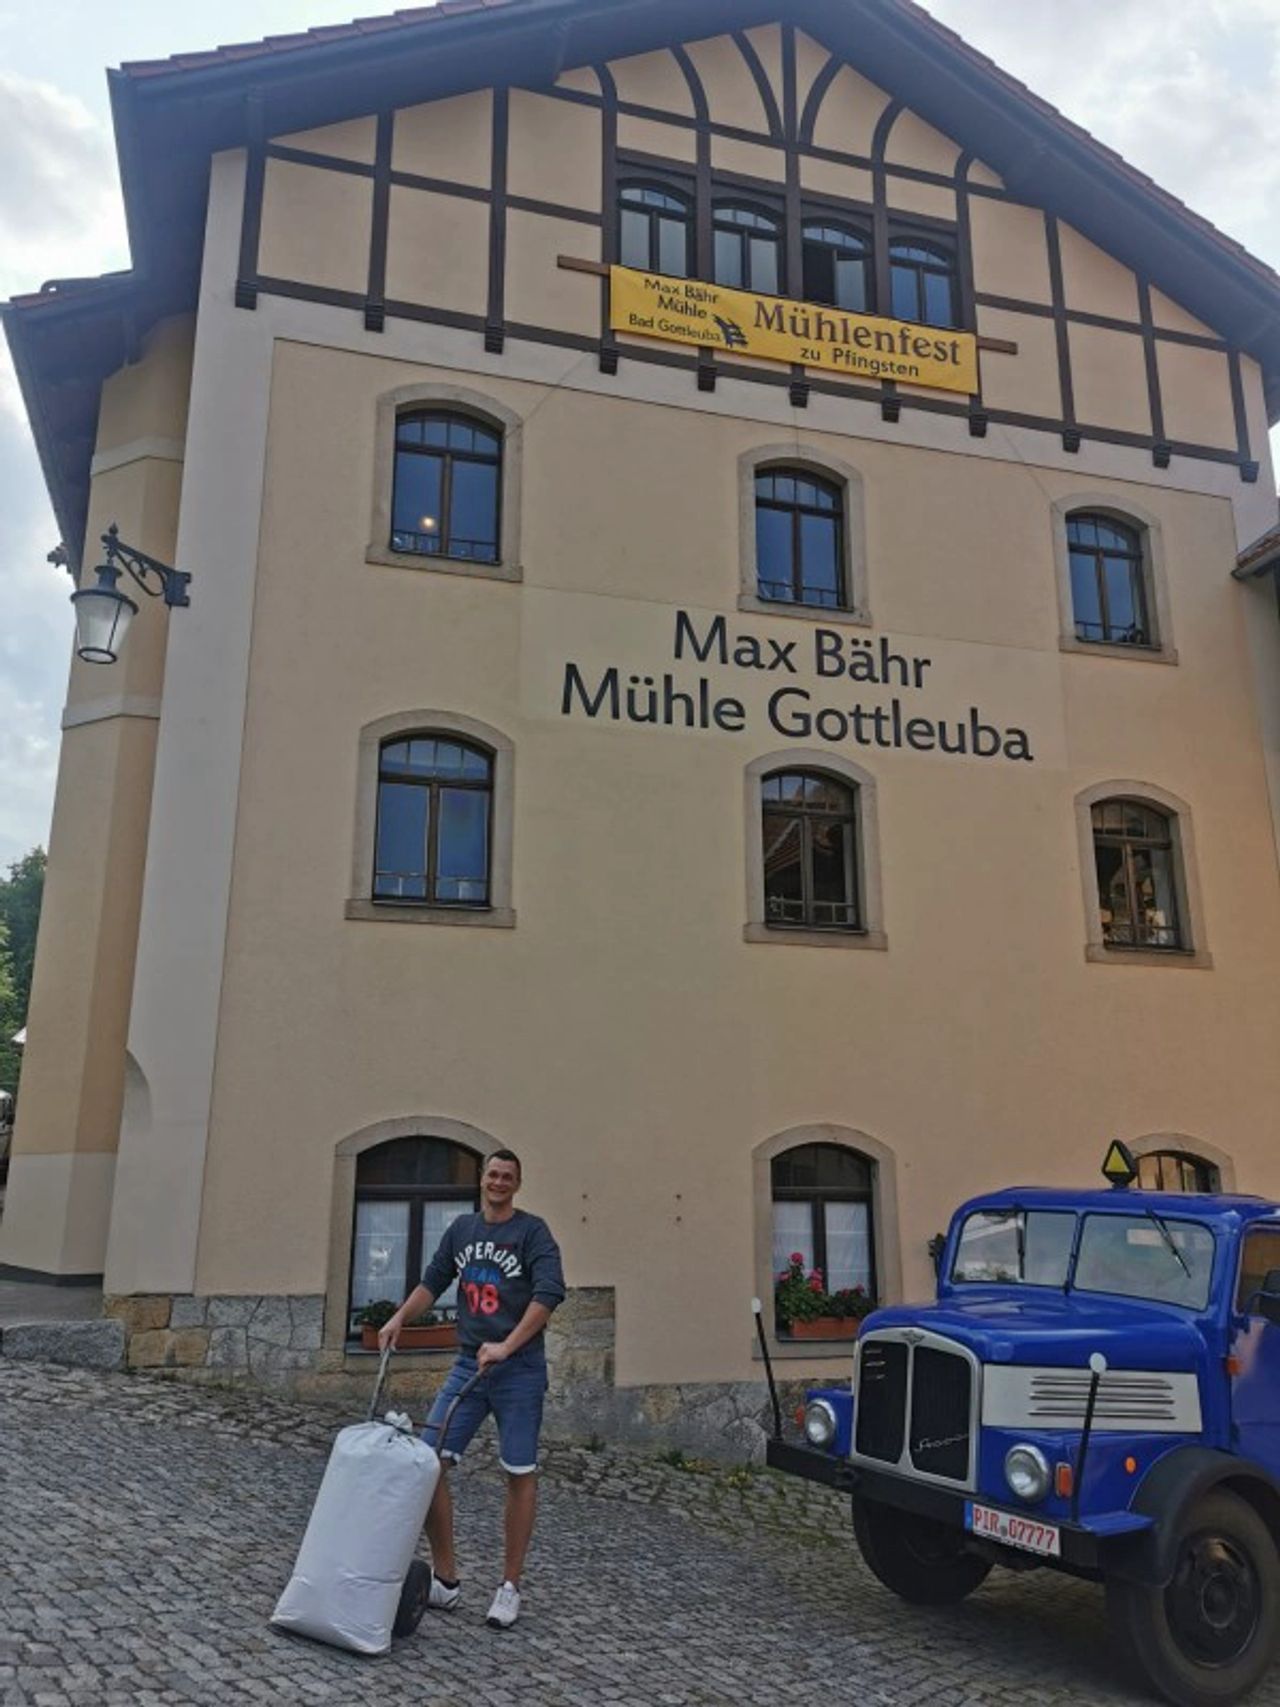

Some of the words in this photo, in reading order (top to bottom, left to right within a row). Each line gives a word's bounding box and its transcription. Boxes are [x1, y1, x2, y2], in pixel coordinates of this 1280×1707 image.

[644, 278, 681, 296] Max
[684, 284, 719, 305] Bähr
[657, 295, 708, 319] Mühle
[629, 313, 654, 329] Bad
[657, 319, 722, 342] Gottleuba
[753, 300, 961, 366] Mühlenfest
[801, 348, 821, 362] zu
[832, 347, 919, 378] Pfingsten
[673, 610, 798, 673] Max
[815, 628, 931, 688] Bähr
[561, 663, 746, 731] Mühle
[767, 686, 1034, 762] Gottleuba
[974, 1507, 1000, 1533] PIR
